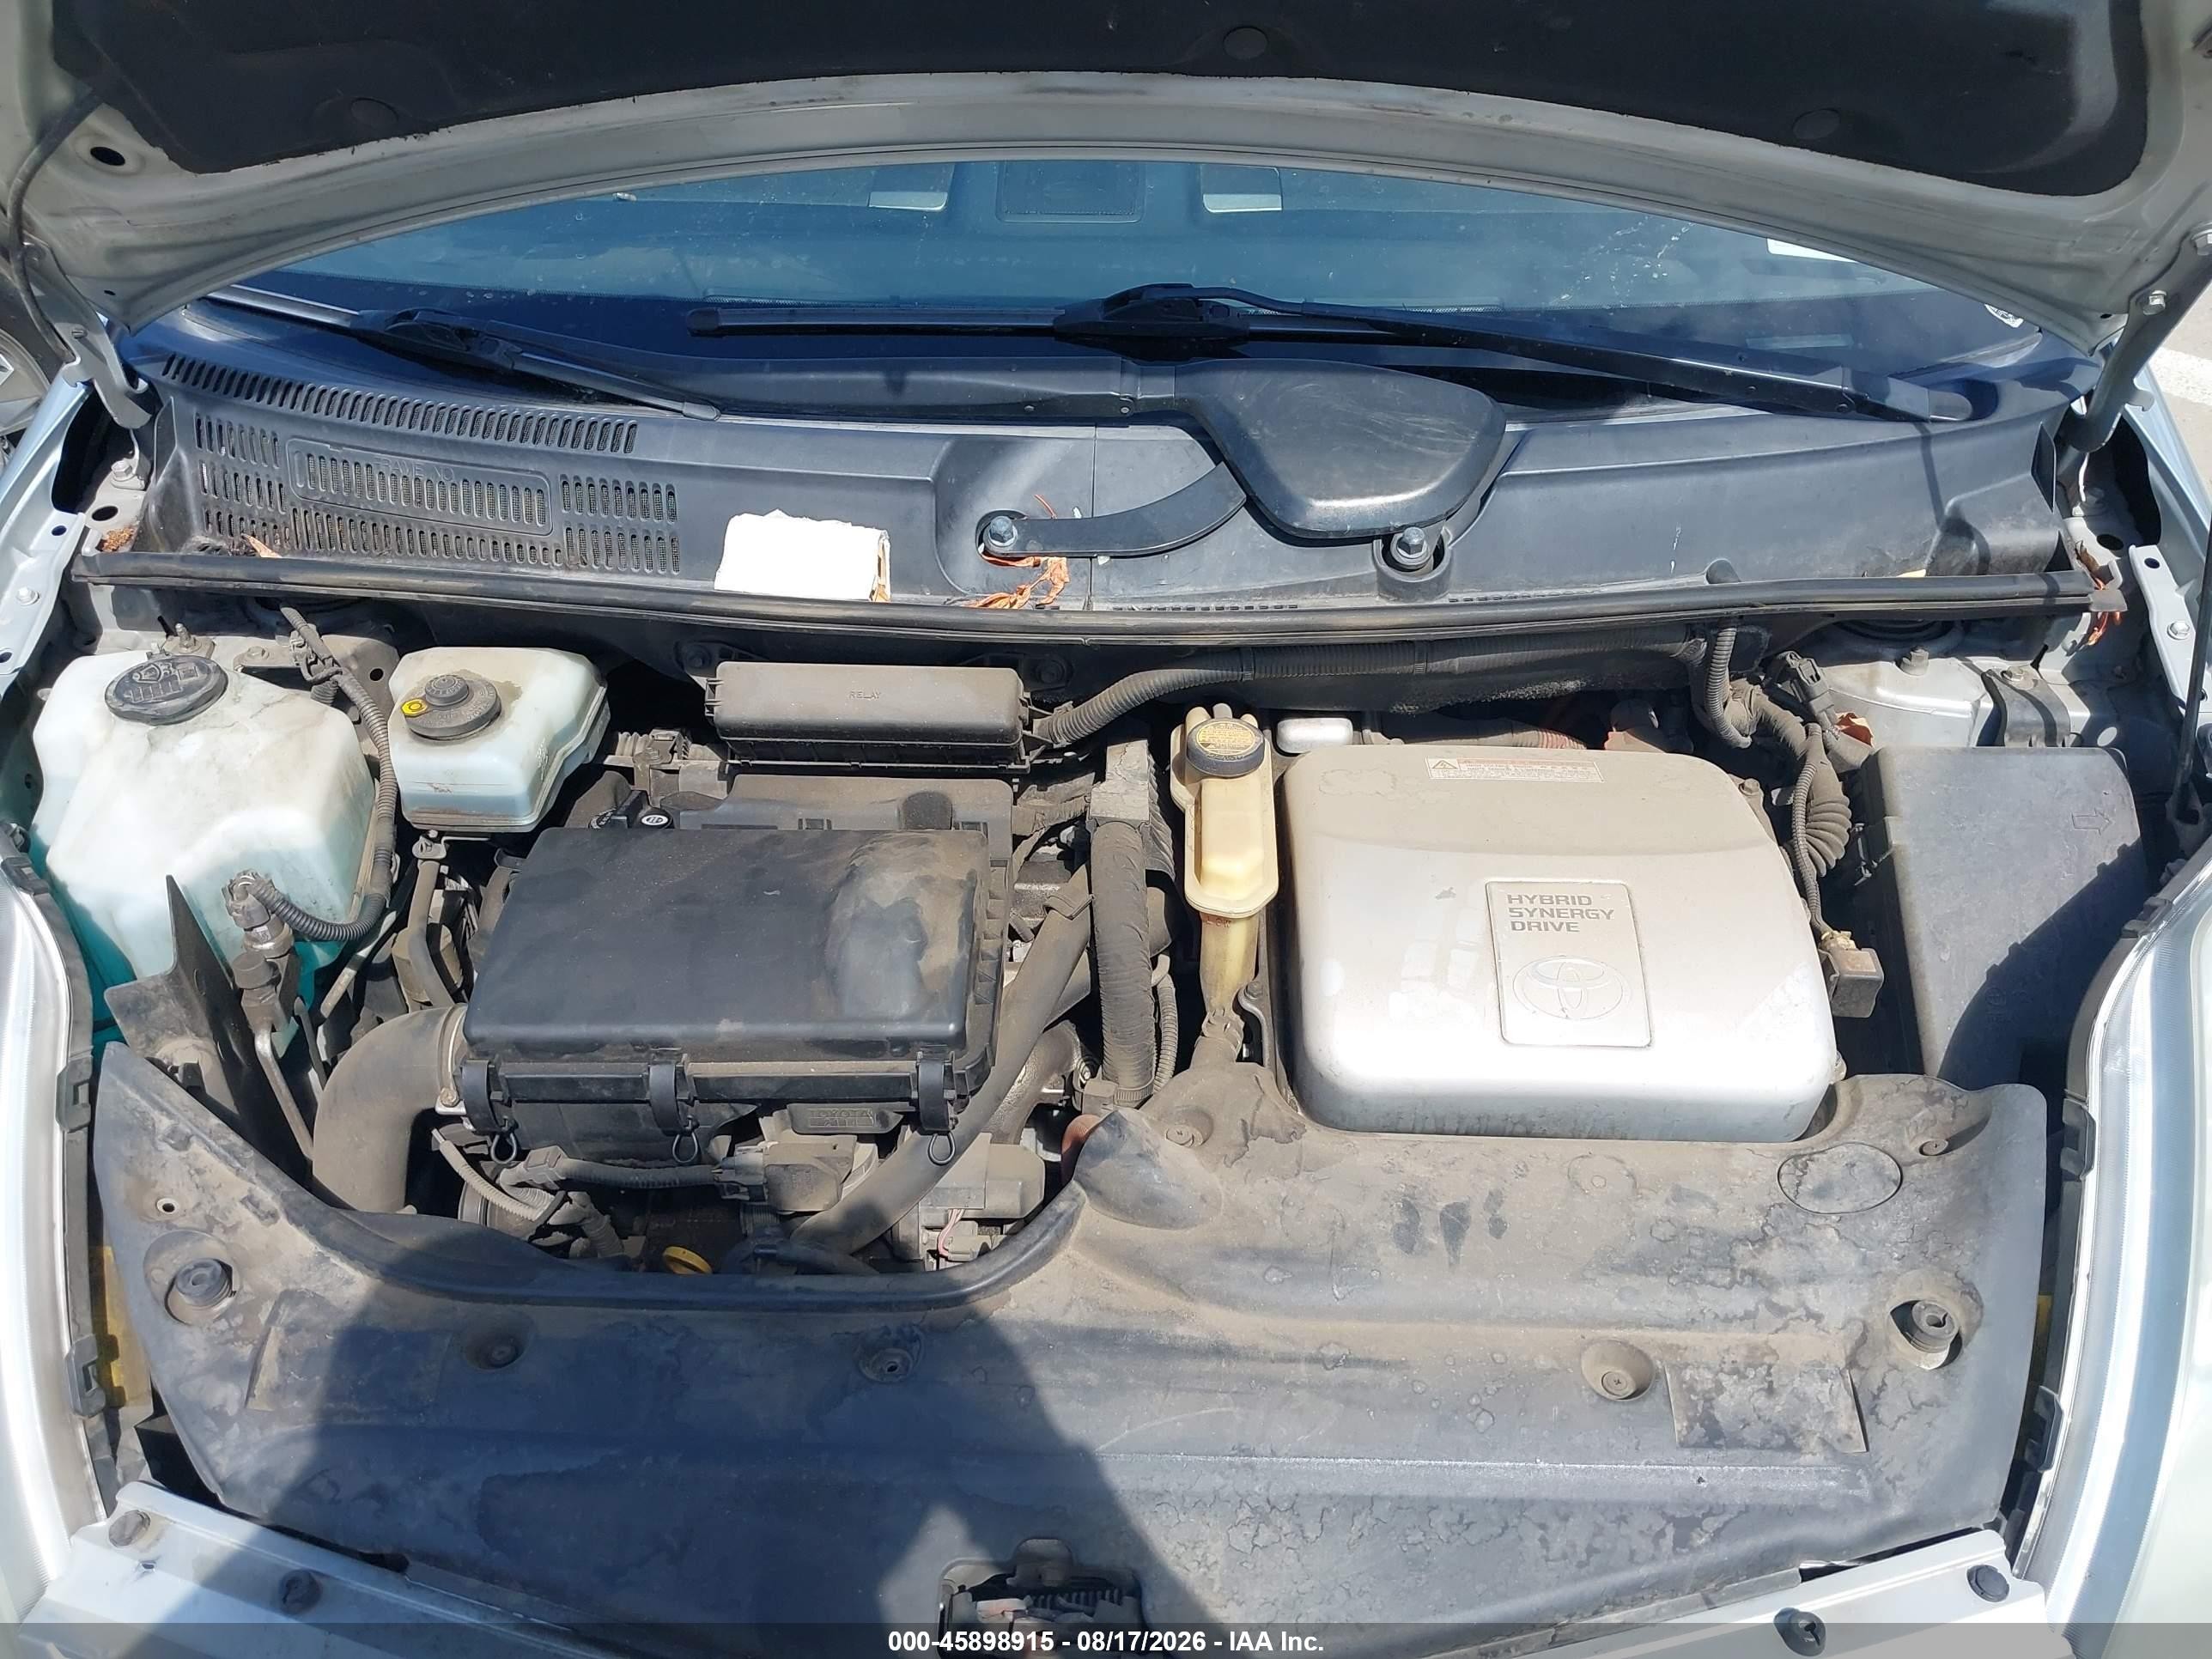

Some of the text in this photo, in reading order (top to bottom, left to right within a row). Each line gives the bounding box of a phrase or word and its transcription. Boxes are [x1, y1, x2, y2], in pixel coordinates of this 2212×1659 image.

[848, 690, 880, 701] RELAY
[1507, 894, 1592, 906] HYBRID
[1509, 907, 1614, 920] SYNERGY
[1510, 921, 1580, 933] DRIVE
